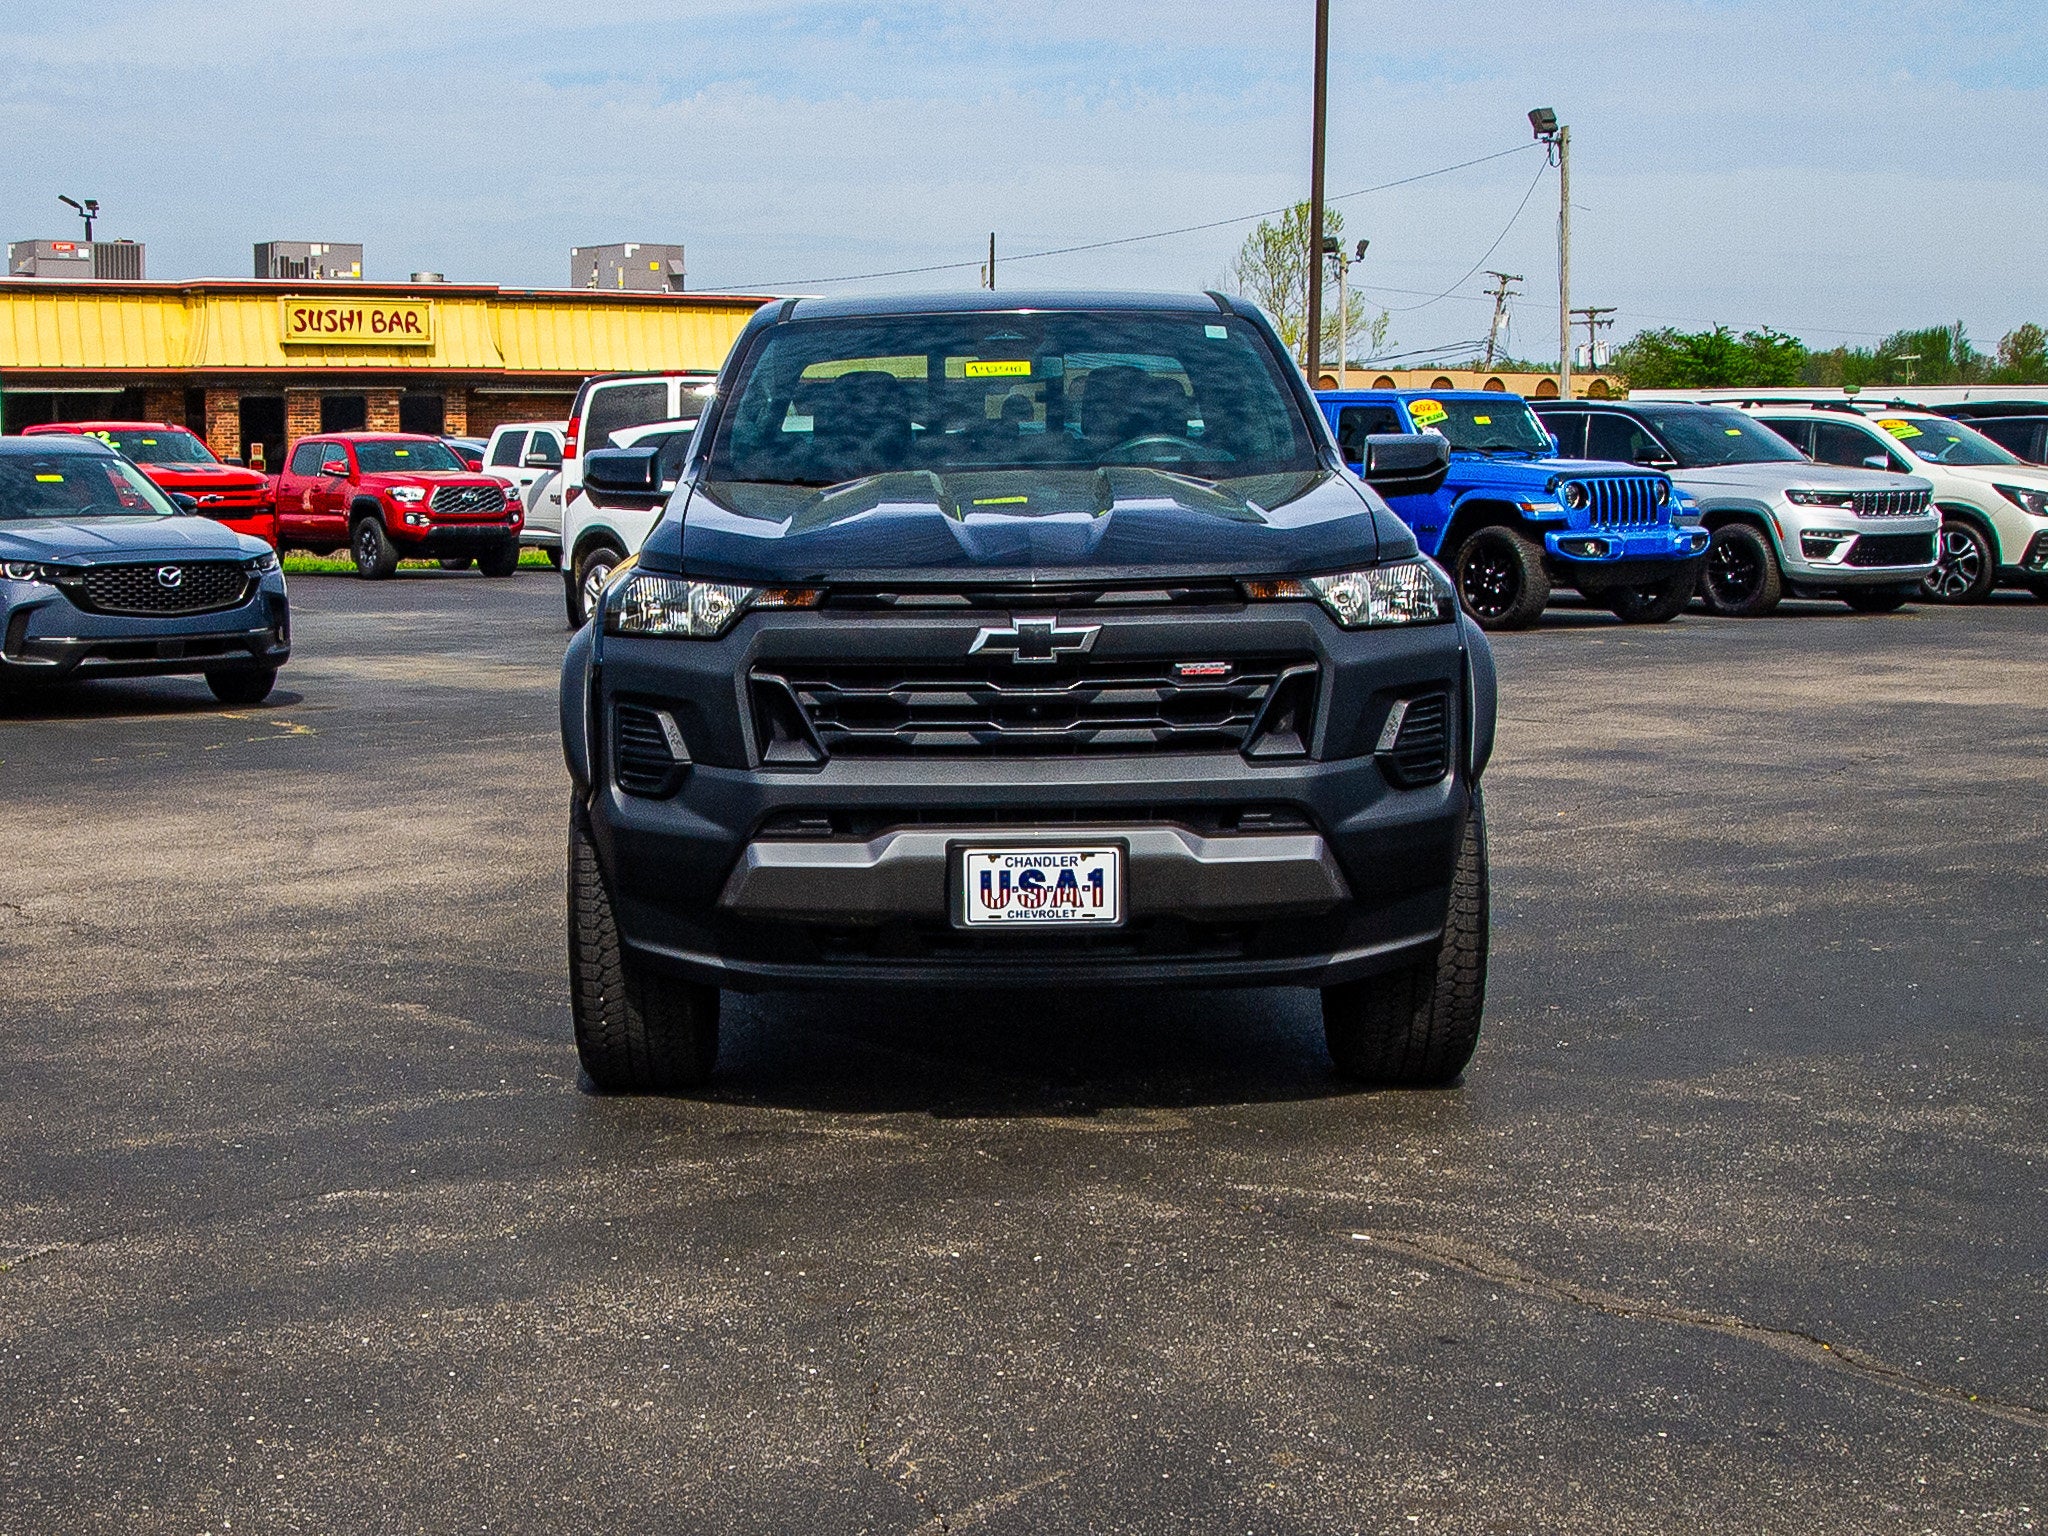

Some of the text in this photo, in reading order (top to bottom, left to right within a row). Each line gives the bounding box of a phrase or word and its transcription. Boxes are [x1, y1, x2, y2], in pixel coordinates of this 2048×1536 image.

[293, 308, 422, 333] SUSHI BAR
[1004, 856, 1079, 868] CHANDLER
[1007, 909, 1077, 919] CHEVROLET
